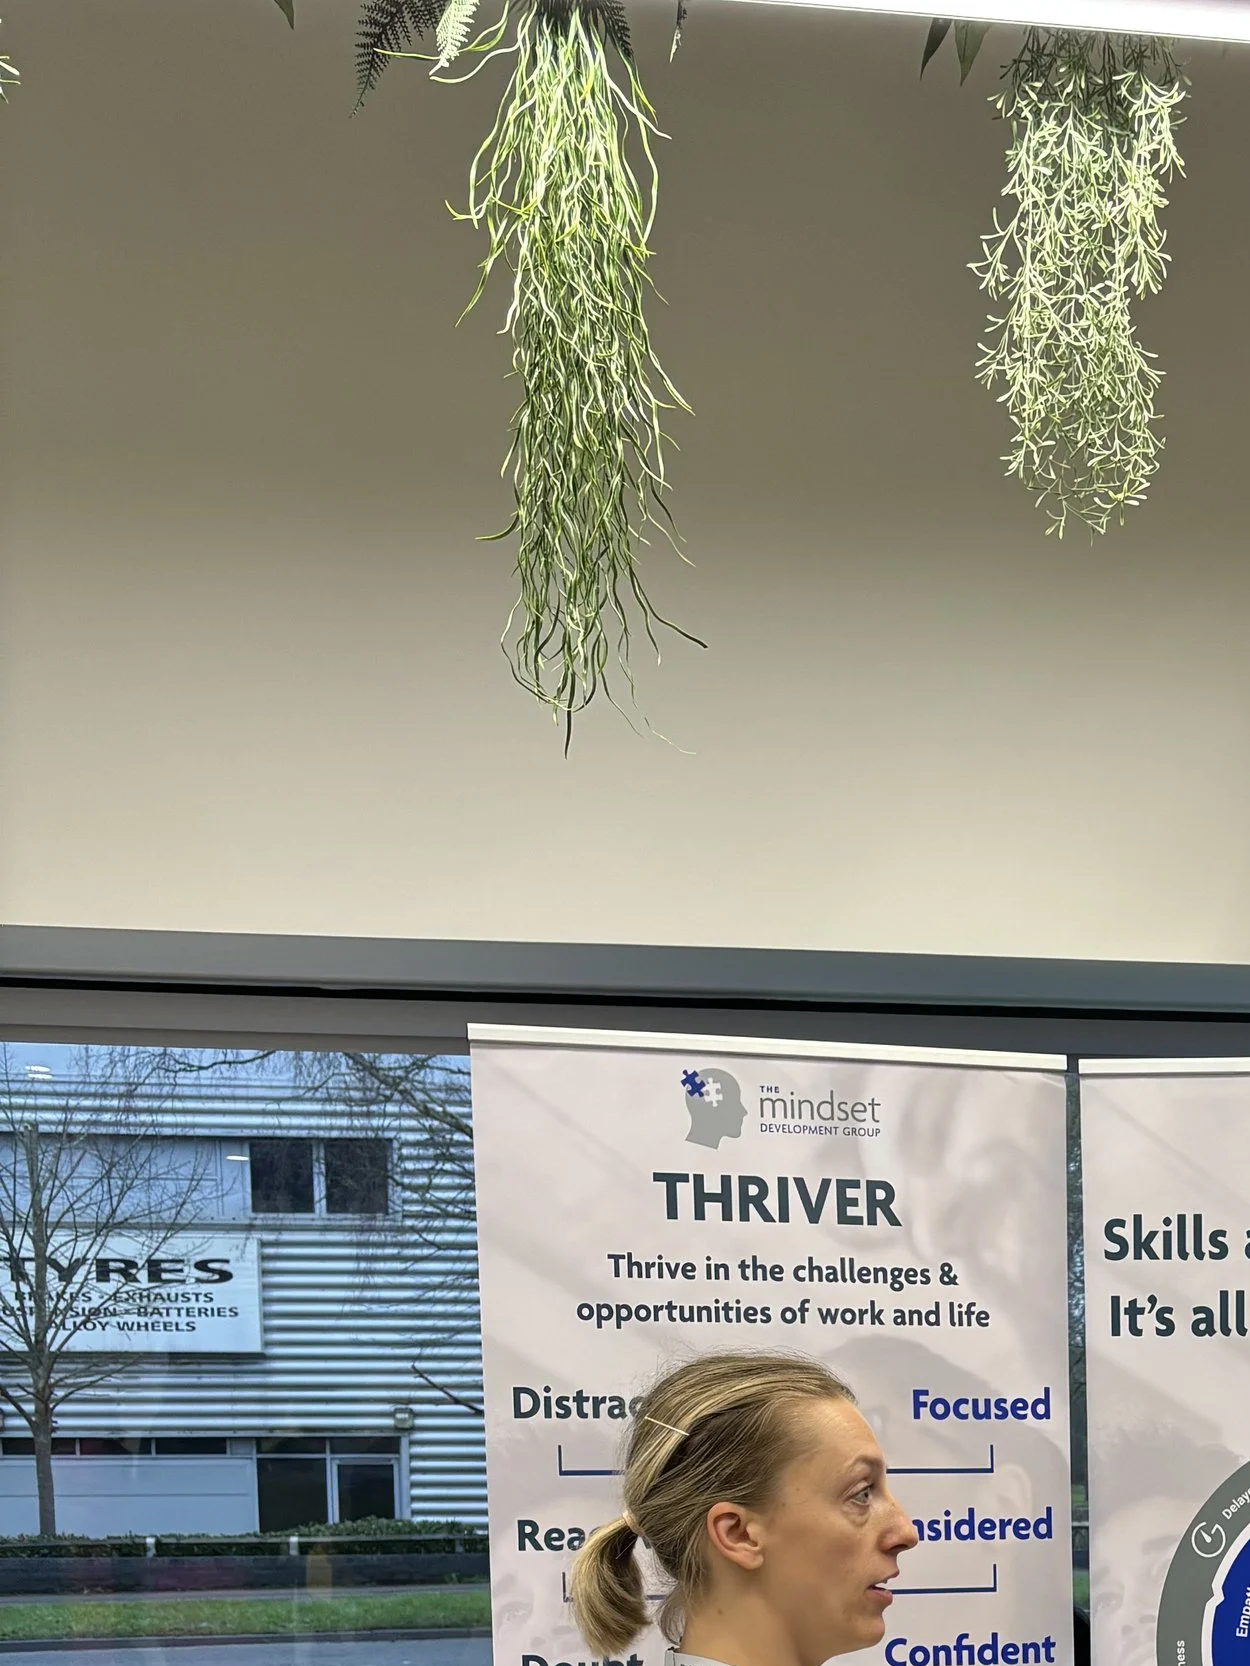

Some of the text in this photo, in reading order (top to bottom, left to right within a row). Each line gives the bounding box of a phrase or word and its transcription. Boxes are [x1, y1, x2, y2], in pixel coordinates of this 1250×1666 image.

[759, 1085, 780, 1094] THE
[759, 1090, 881, 1123] mindset
[759, 1123, 881, 1138] DEVELOPMENT GROUP
[652, 1171, 902, 1227] THRIVER
[1103, 1213, 1229, 1261] Skills
[0, 1257, 234, 1284] TYRES
[607, 1253, 959, 1292] Thrive in the challenges &
[115, 1291, 214, 1303] EXHAUSTS
[137, 1306, 239, 1318] BATTERIES
[118, 1320, 197, 1332] WHEELS
[577, 1298, 991, 1329] opportunities of work and life
[1191, 1290, 1248, 1338] all
[912, 1387, 1052, 1421] Focused
